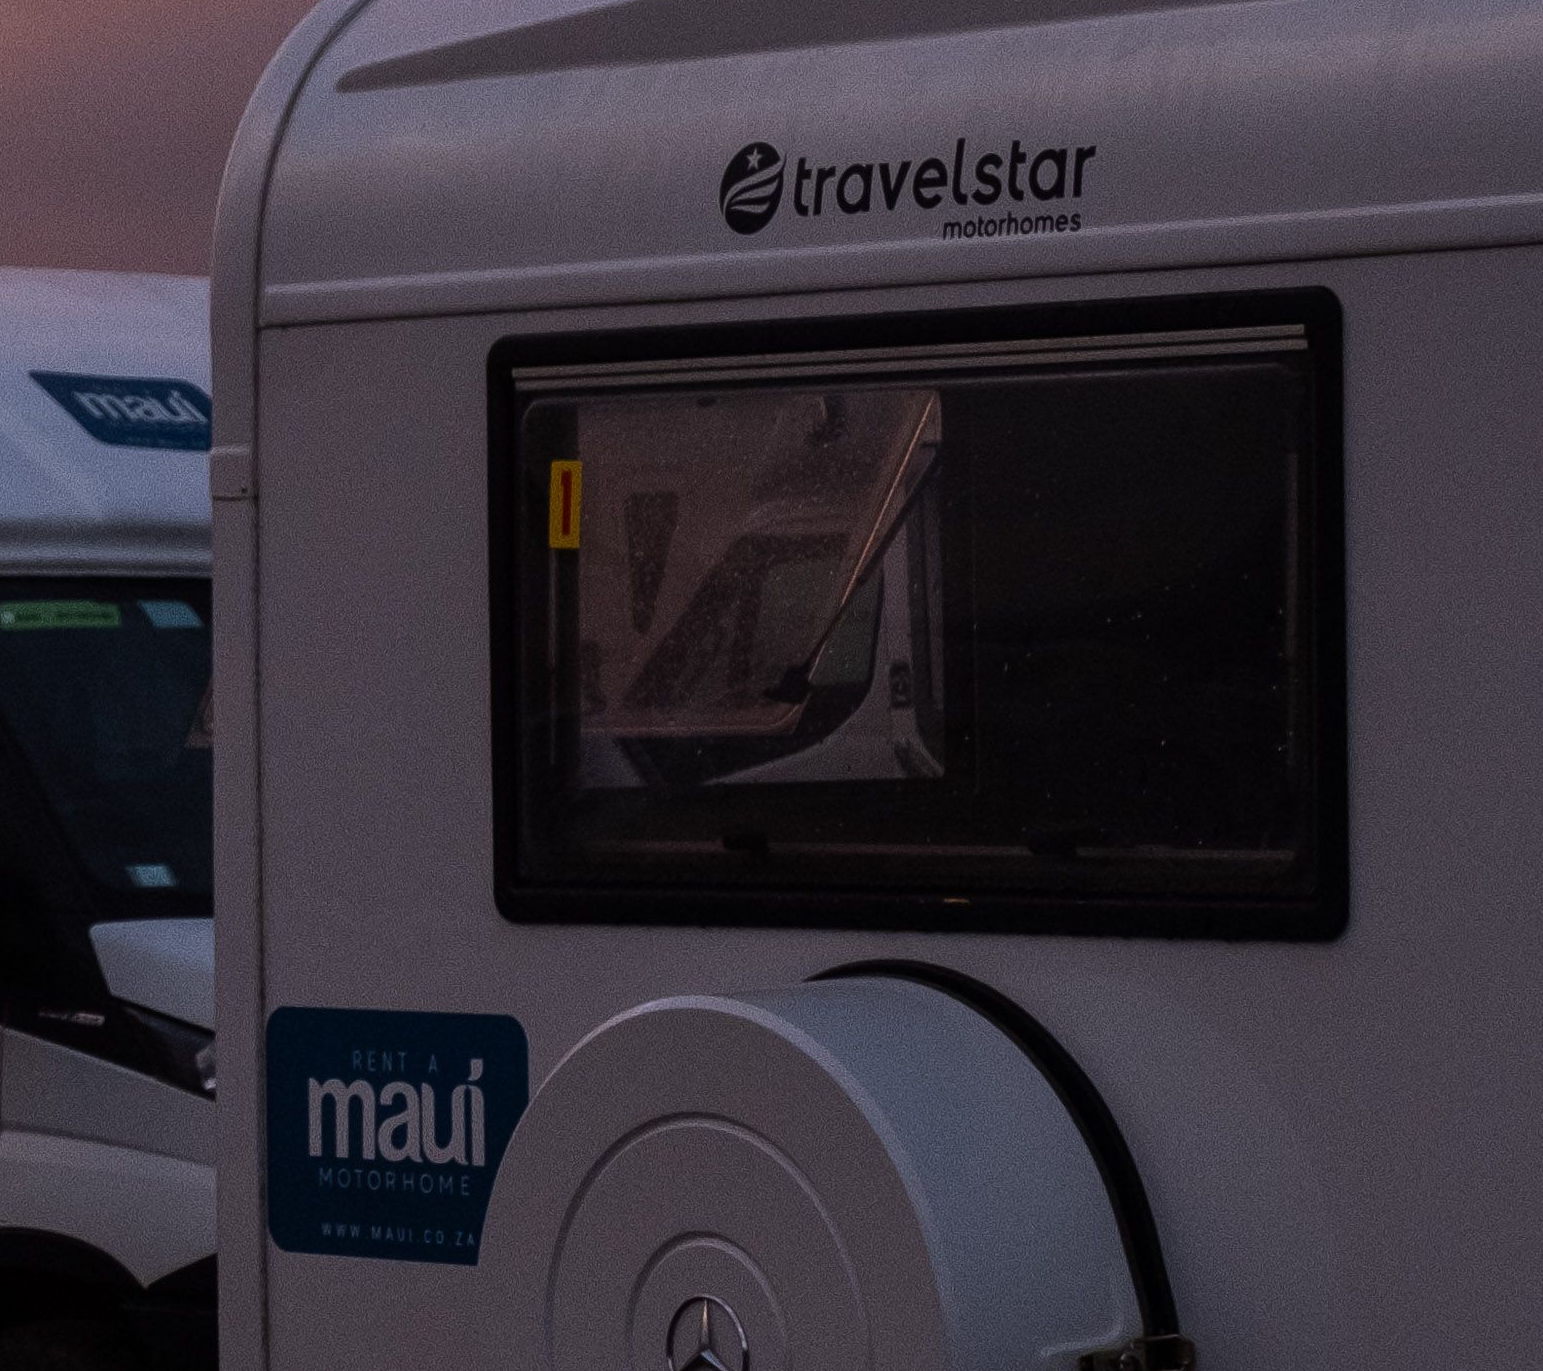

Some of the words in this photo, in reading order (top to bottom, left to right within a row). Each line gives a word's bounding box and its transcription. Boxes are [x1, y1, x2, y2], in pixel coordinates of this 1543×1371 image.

[793, 137, 1097, 217] travelstar
[942, 211, 1082, 240] motorhomes
[351, 1049, 408, 1073] RENT
[427, 1053, 440, 1074] A
[317, 1166, 471, 1196] MOTORHOME
